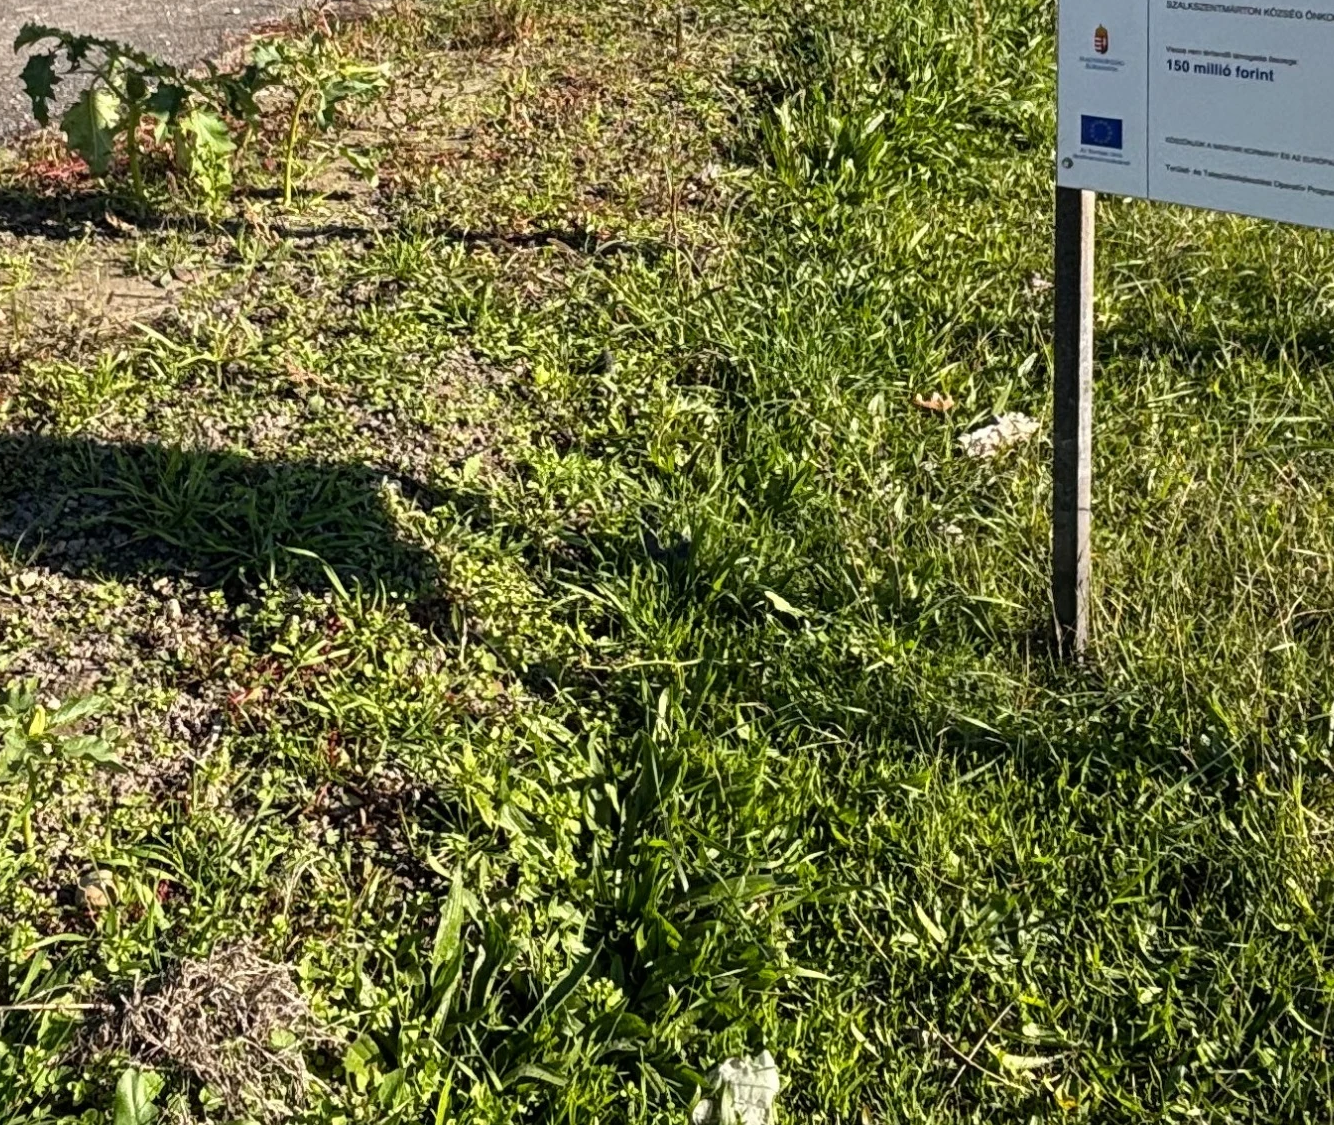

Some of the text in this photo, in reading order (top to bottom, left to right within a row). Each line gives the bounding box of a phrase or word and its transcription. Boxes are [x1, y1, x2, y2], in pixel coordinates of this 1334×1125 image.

[1166, 59, 1274, 82] 150 millió forint
